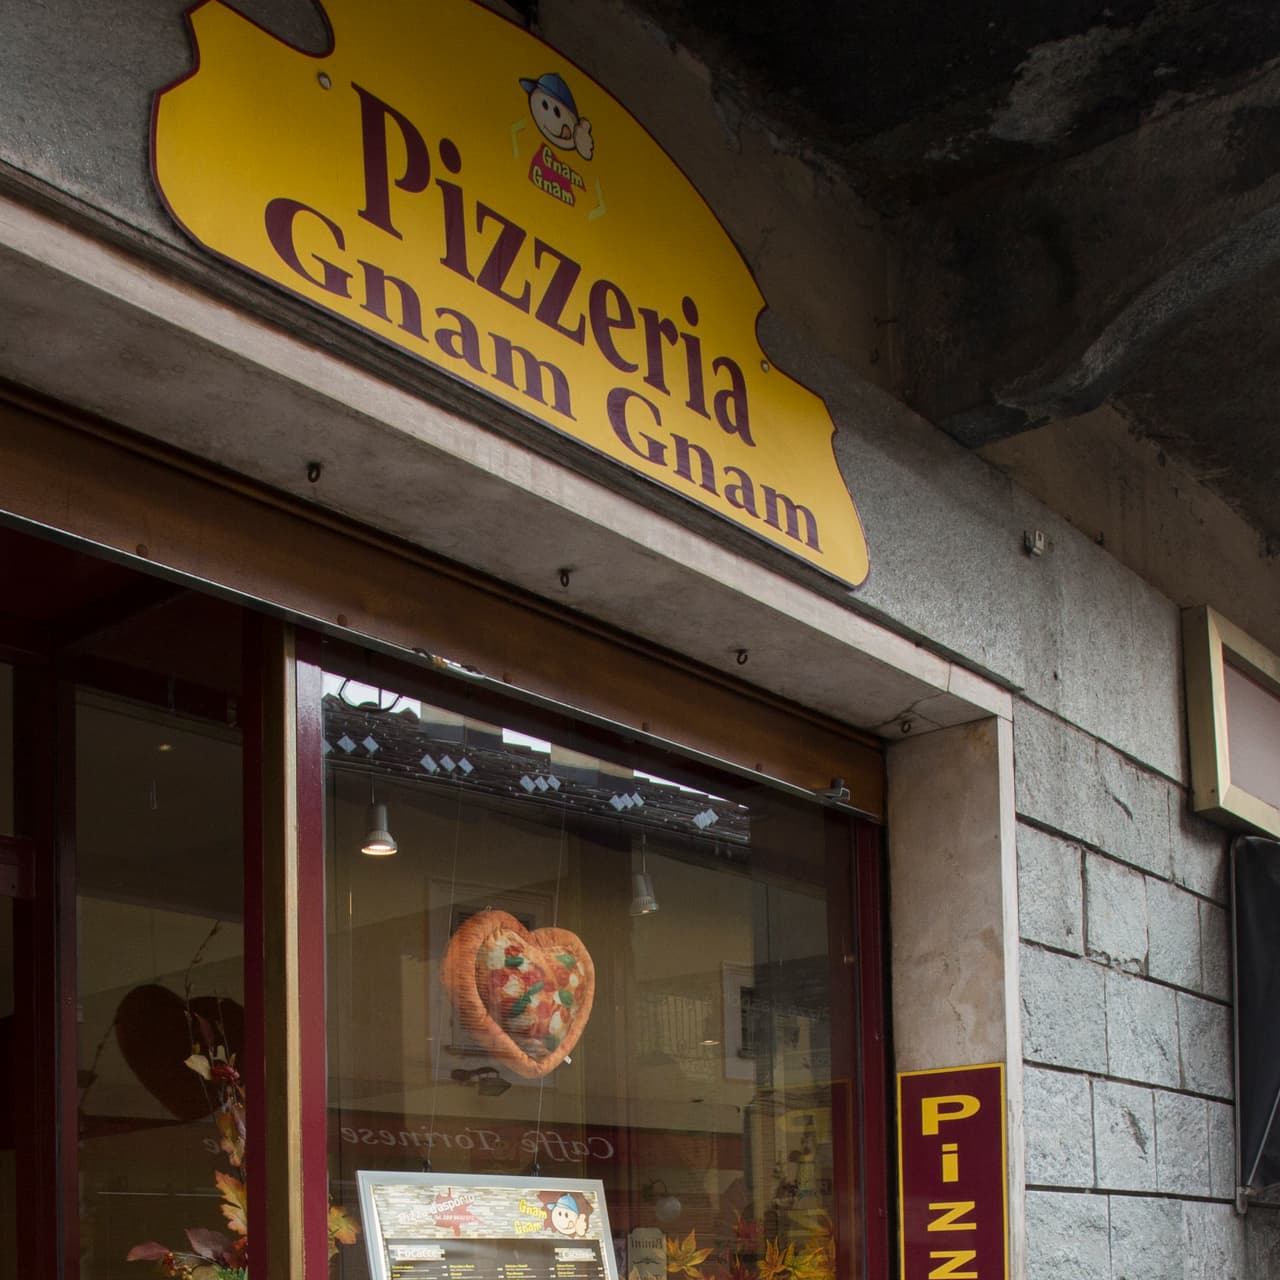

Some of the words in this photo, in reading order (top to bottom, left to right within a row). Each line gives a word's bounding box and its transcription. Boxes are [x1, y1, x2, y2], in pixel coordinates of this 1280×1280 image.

[532, 165, 574, 205] Gnam
[542, 146, 584, 187] Gnam
[350, 80, 757, 448] Pizzeria
[264, 197, 578, 421] Gnam
[606, 386, 824, 555] Gnam
[518, 1199, 548, 1220] Gnam
